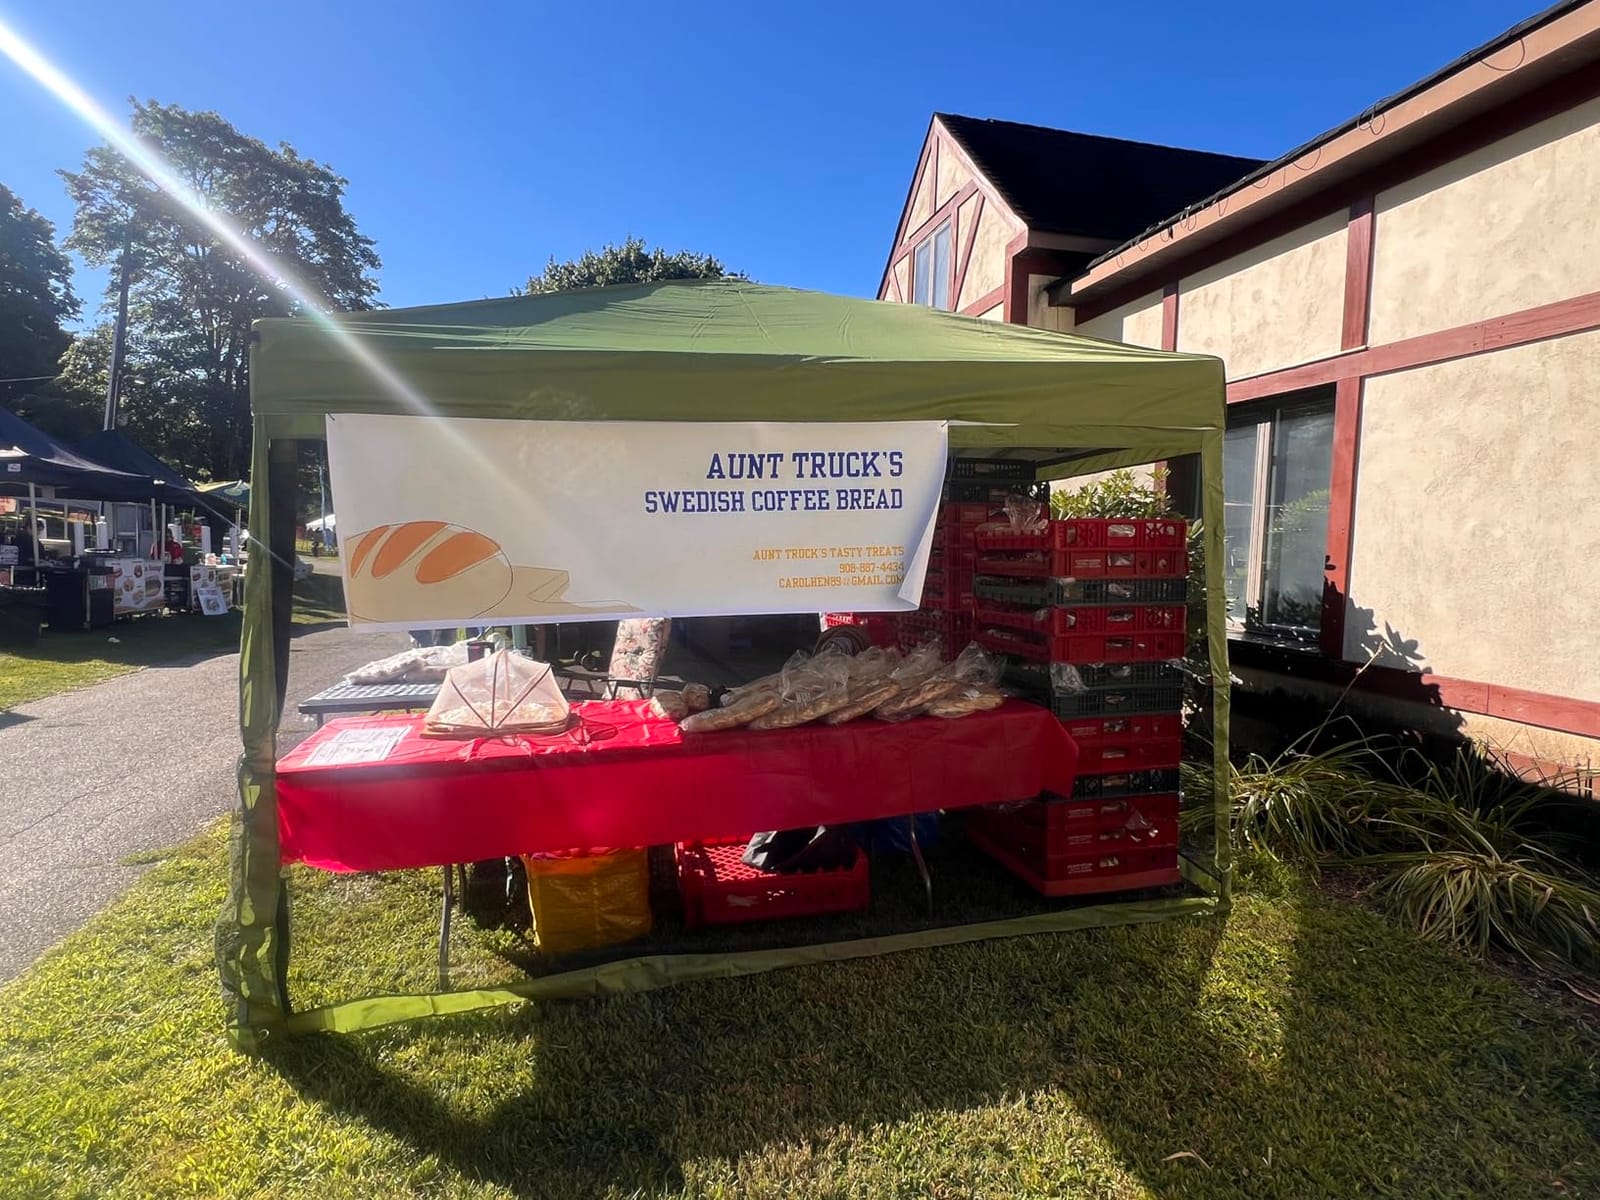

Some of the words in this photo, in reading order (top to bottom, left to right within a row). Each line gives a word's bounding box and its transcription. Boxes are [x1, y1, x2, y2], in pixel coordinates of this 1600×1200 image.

[706, 453, 784, 479] AUNT
[792, 451, 903, 478] TRUCK'S
[645, 491, 745, 513] SWEDISH
[752, 489, 830, 512] COFFEE
[836, 488, 903, 510] BREAD
[753, 549, 782, 561] AUNT
[785, 548, 828, 560] TRUCK'S
[830, 547, 864, 558] TASTY
[866, 546, 905, 557] TREATS
